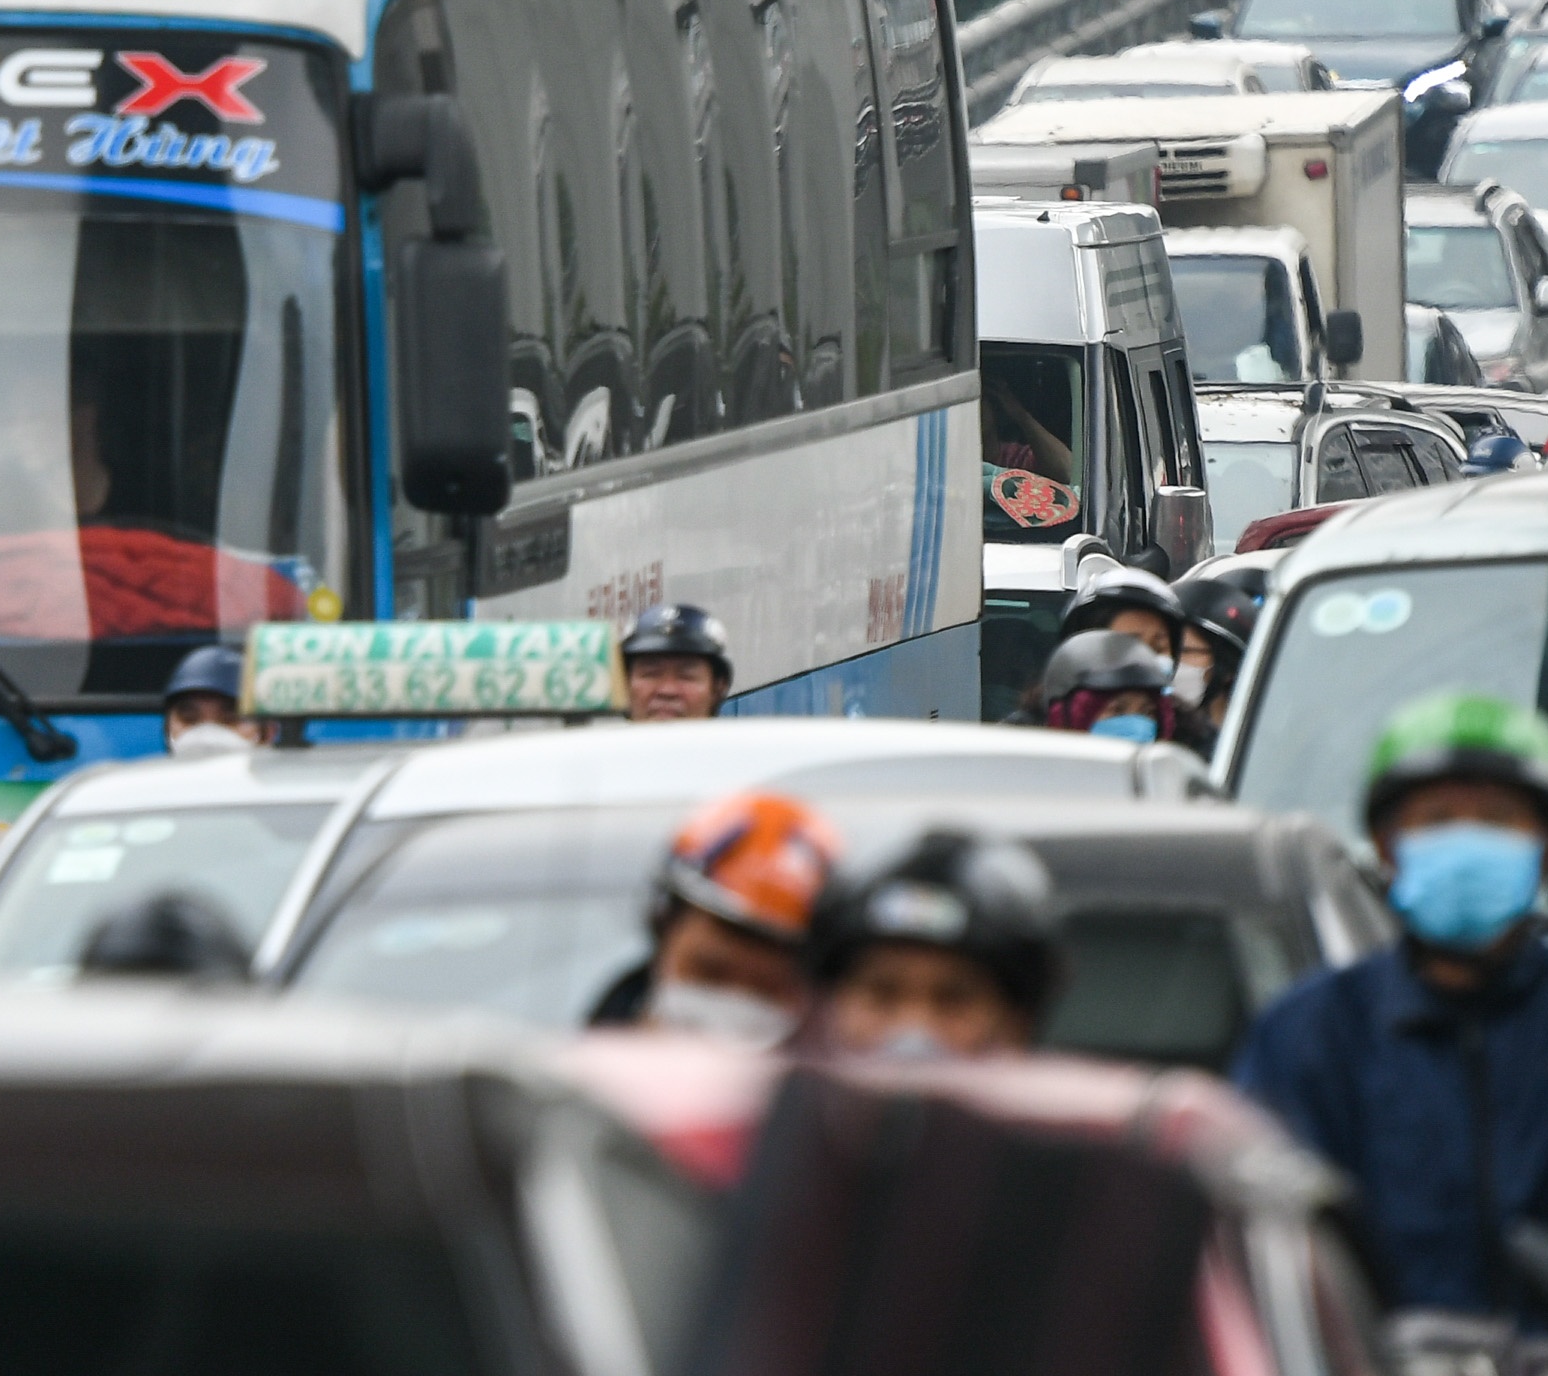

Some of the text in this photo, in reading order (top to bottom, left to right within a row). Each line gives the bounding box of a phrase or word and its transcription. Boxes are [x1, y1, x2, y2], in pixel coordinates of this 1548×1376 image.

[115, 50, 267, 124] X
[494, 624, 607, 663] TAXI
[405, 664, 460, 711] 62
[474, 664, 527, 711] 62
[544, 662, 600, 711] 62
